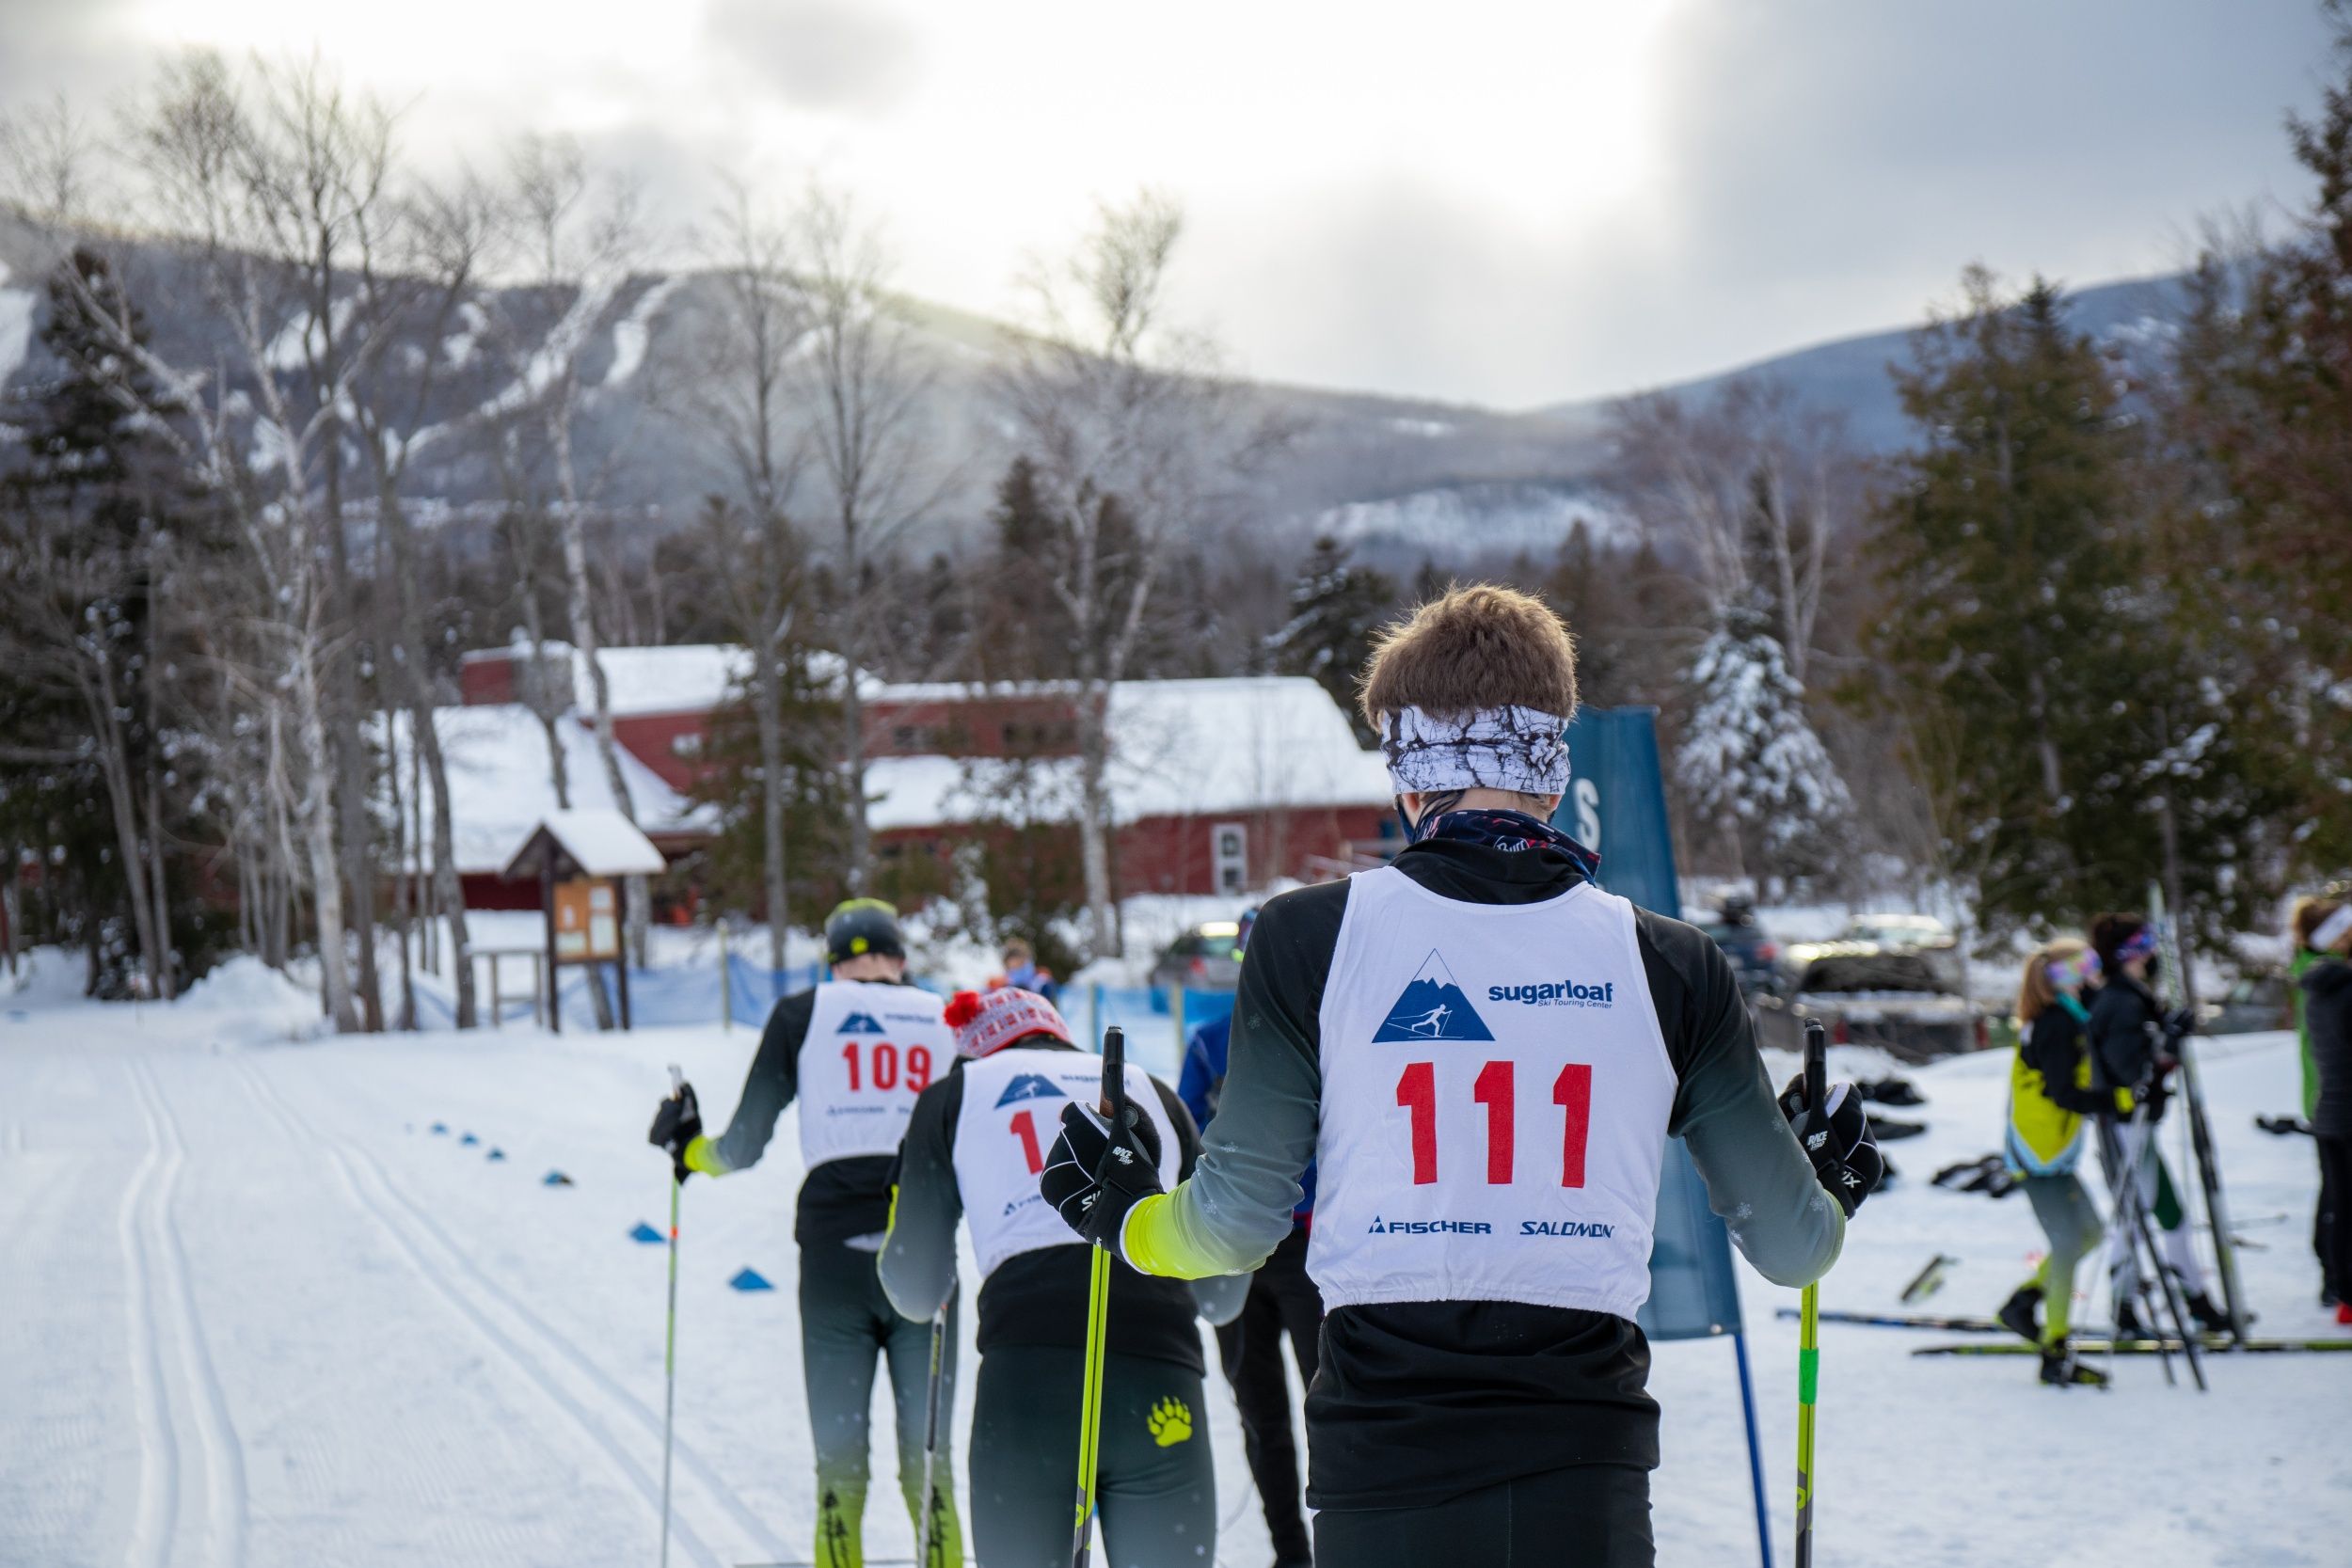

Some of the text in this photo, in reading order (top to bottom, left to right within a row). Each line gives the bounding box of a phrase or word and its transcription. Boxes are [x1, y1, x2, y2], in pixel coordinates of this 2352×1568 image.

[1488, 979, 1613, 1005] sugarloaf
[1553, 999, 1585, 1008] Touring
[1586, 1000, 1613, 1009] Center
[842, 1041, 931, 1094] 109
[1396, 1061, 1592, 1188] 111
[1807, 1131, 1828, 1146] RACE
[1112, 1146, 1133, 1157] RACE
[1389, 1220, 1614, 1238] FISCHER SALOMON
